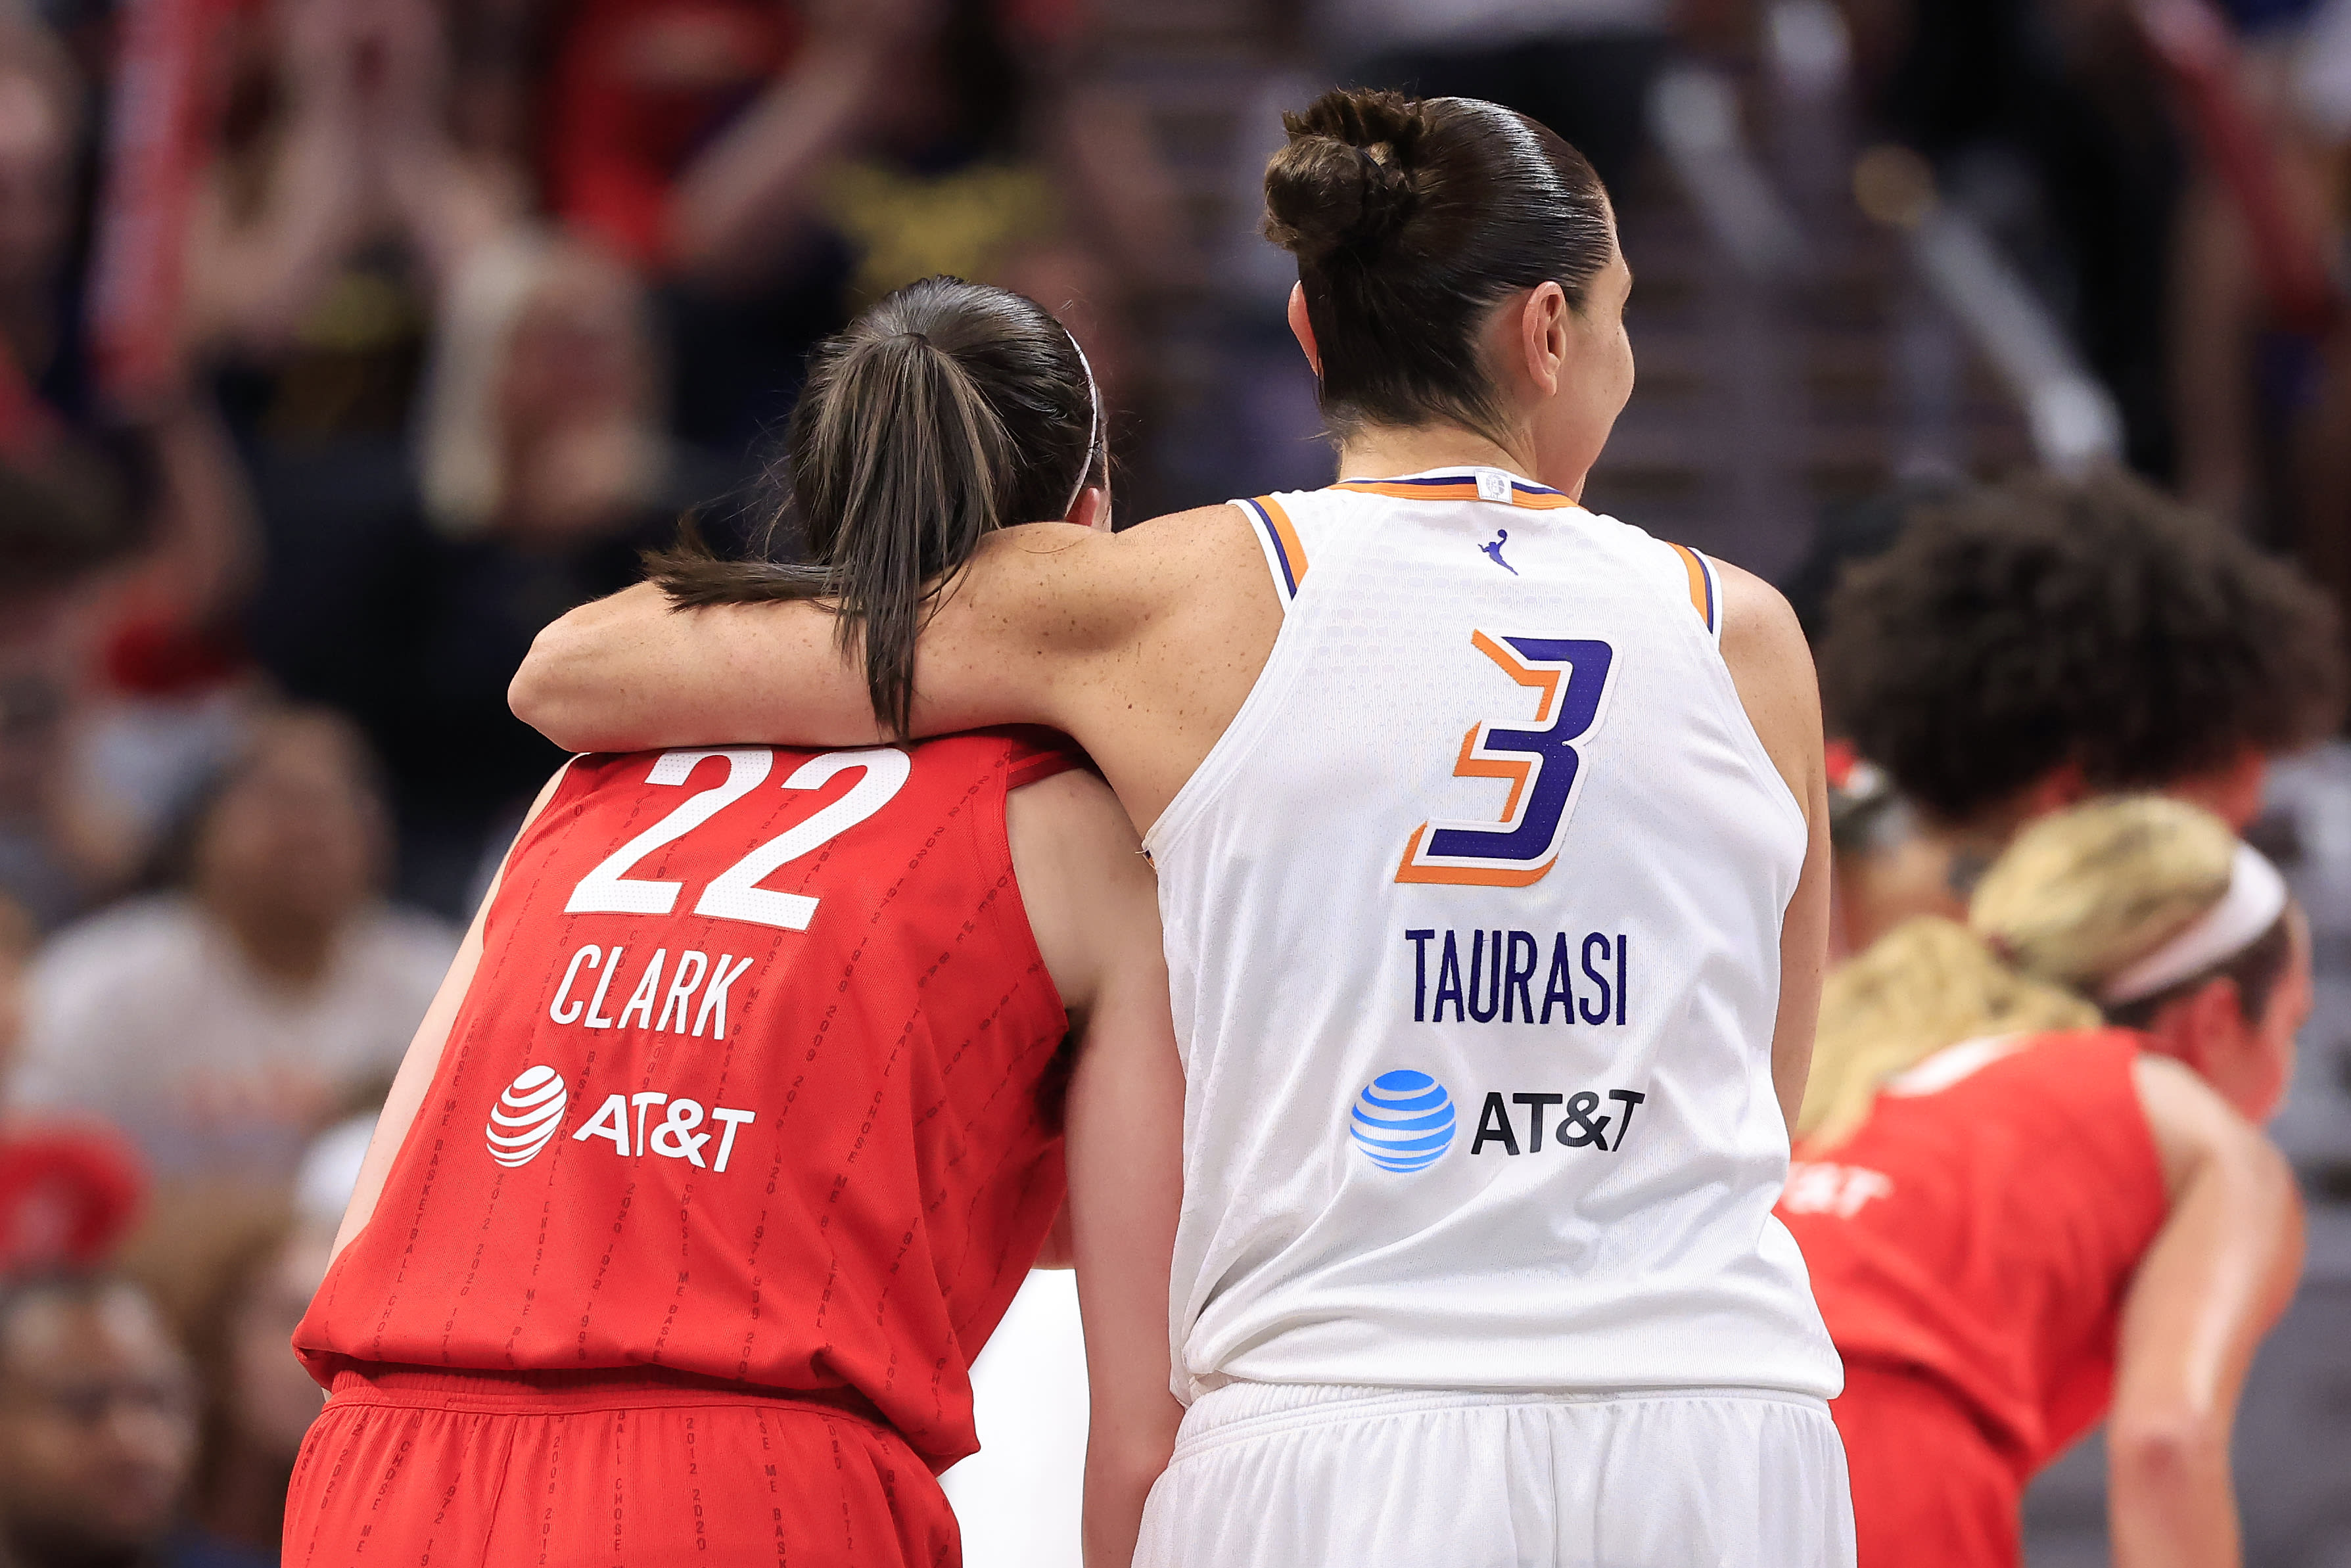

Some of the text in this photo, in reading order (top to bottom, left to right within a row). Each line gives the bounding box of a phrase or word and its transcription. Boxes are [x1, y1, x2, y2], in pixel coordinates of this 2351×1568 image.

[1394, 628, 1624, 888] 3
[565, 748, 911, 931] 22
[908, 825, 945, 869] 2020
[870, 877, 905, 924] 1972
[549, 944, 754, 1040] CLARK
[837, 936, 868, 993] 1999
[1405, 929, 1627, 1026] TAURASI
[805, 1004, 837, 1062] 2009
[572, 1092, 756, 1172] AT&T
[774, 1074, 804, 1130] 2012
[847, 1090, 883, 1164] CHOSE
[1471, 1088, 1646, 1156] AT&T
[397, 1138, 444, 1283] BASKETBALL
[828, 1172, 849, 1203] ME
[592, 1243, 614, 1291] 1972
[889, 1216, 919, 1276] 1972
[676, 1271, 689, 1297] ME
[577, 1301, 592, 1362] 1999
[356, 1439, 411, 1554] CHOSE ME
[432, 1472, 461, 1525] 1972
[538, 1436, 561, 1565] 2009 2012
[686, 1417, 707, 1552] 2012 2020
[764, 1464, 777, 1492] ME
[613, 1478, 623, 1552] CHOSE
